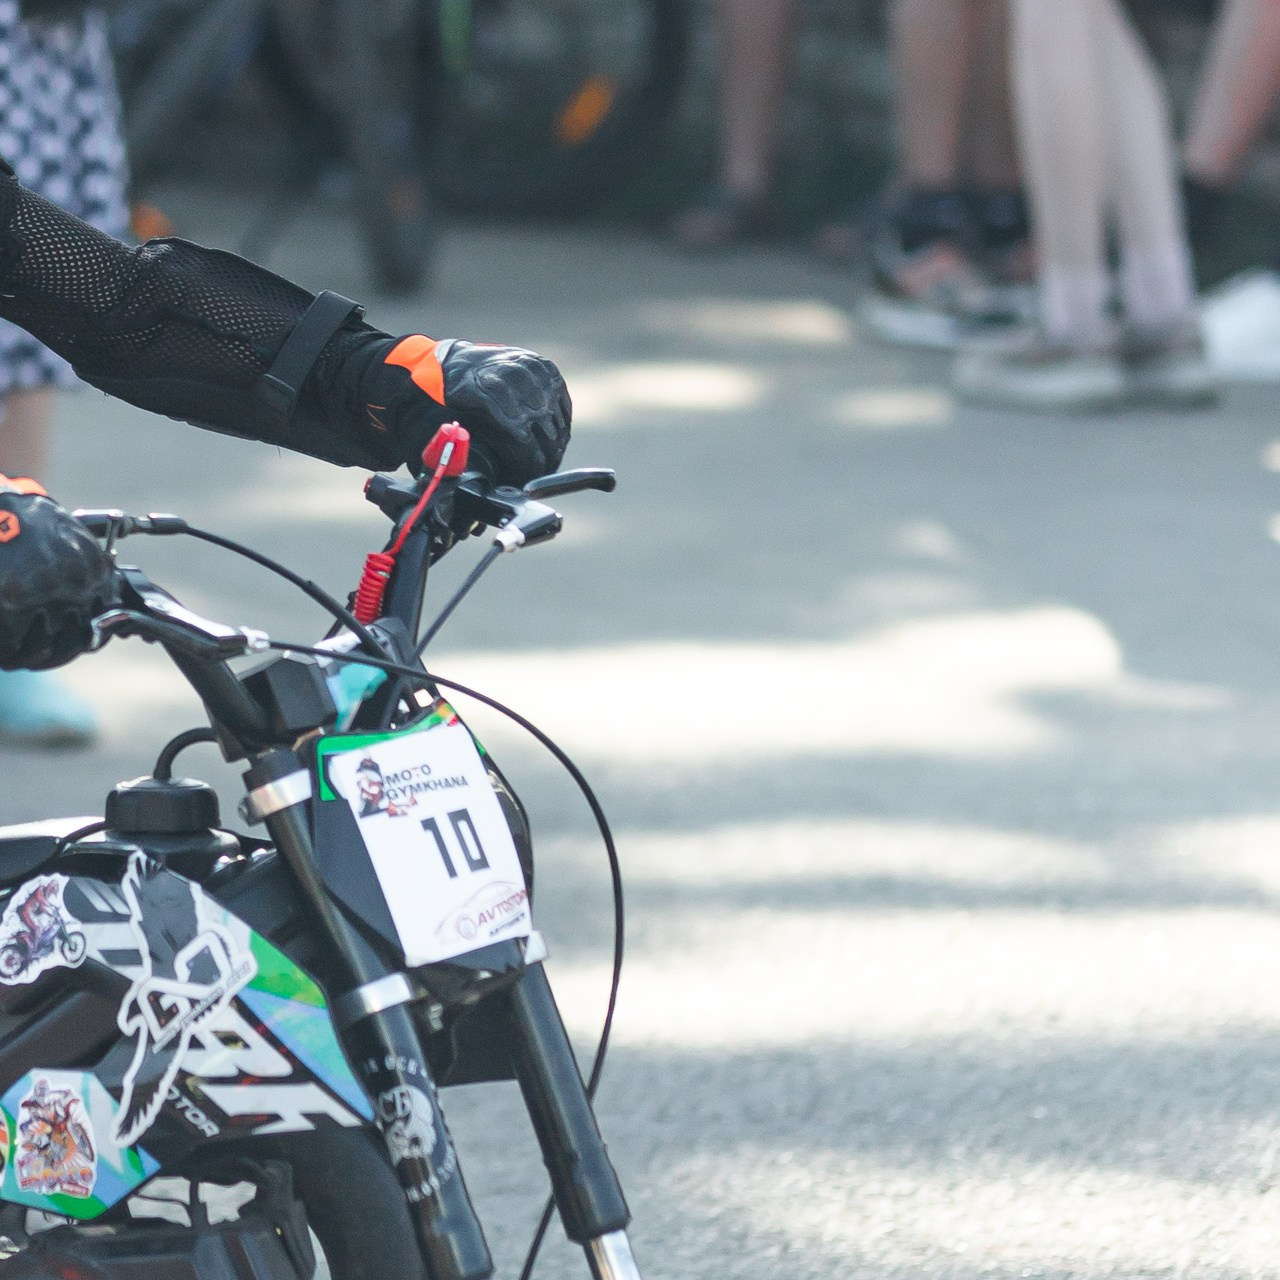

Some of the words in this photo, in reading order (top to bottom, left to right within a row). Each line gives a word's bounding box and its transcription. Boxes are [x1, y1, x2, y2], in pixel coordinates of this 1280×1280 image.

[386, 776, 470, 800] GYMKHANA
[420, 808, 490, 879] 10
[167, 1086, 220, 1138] OTOR
